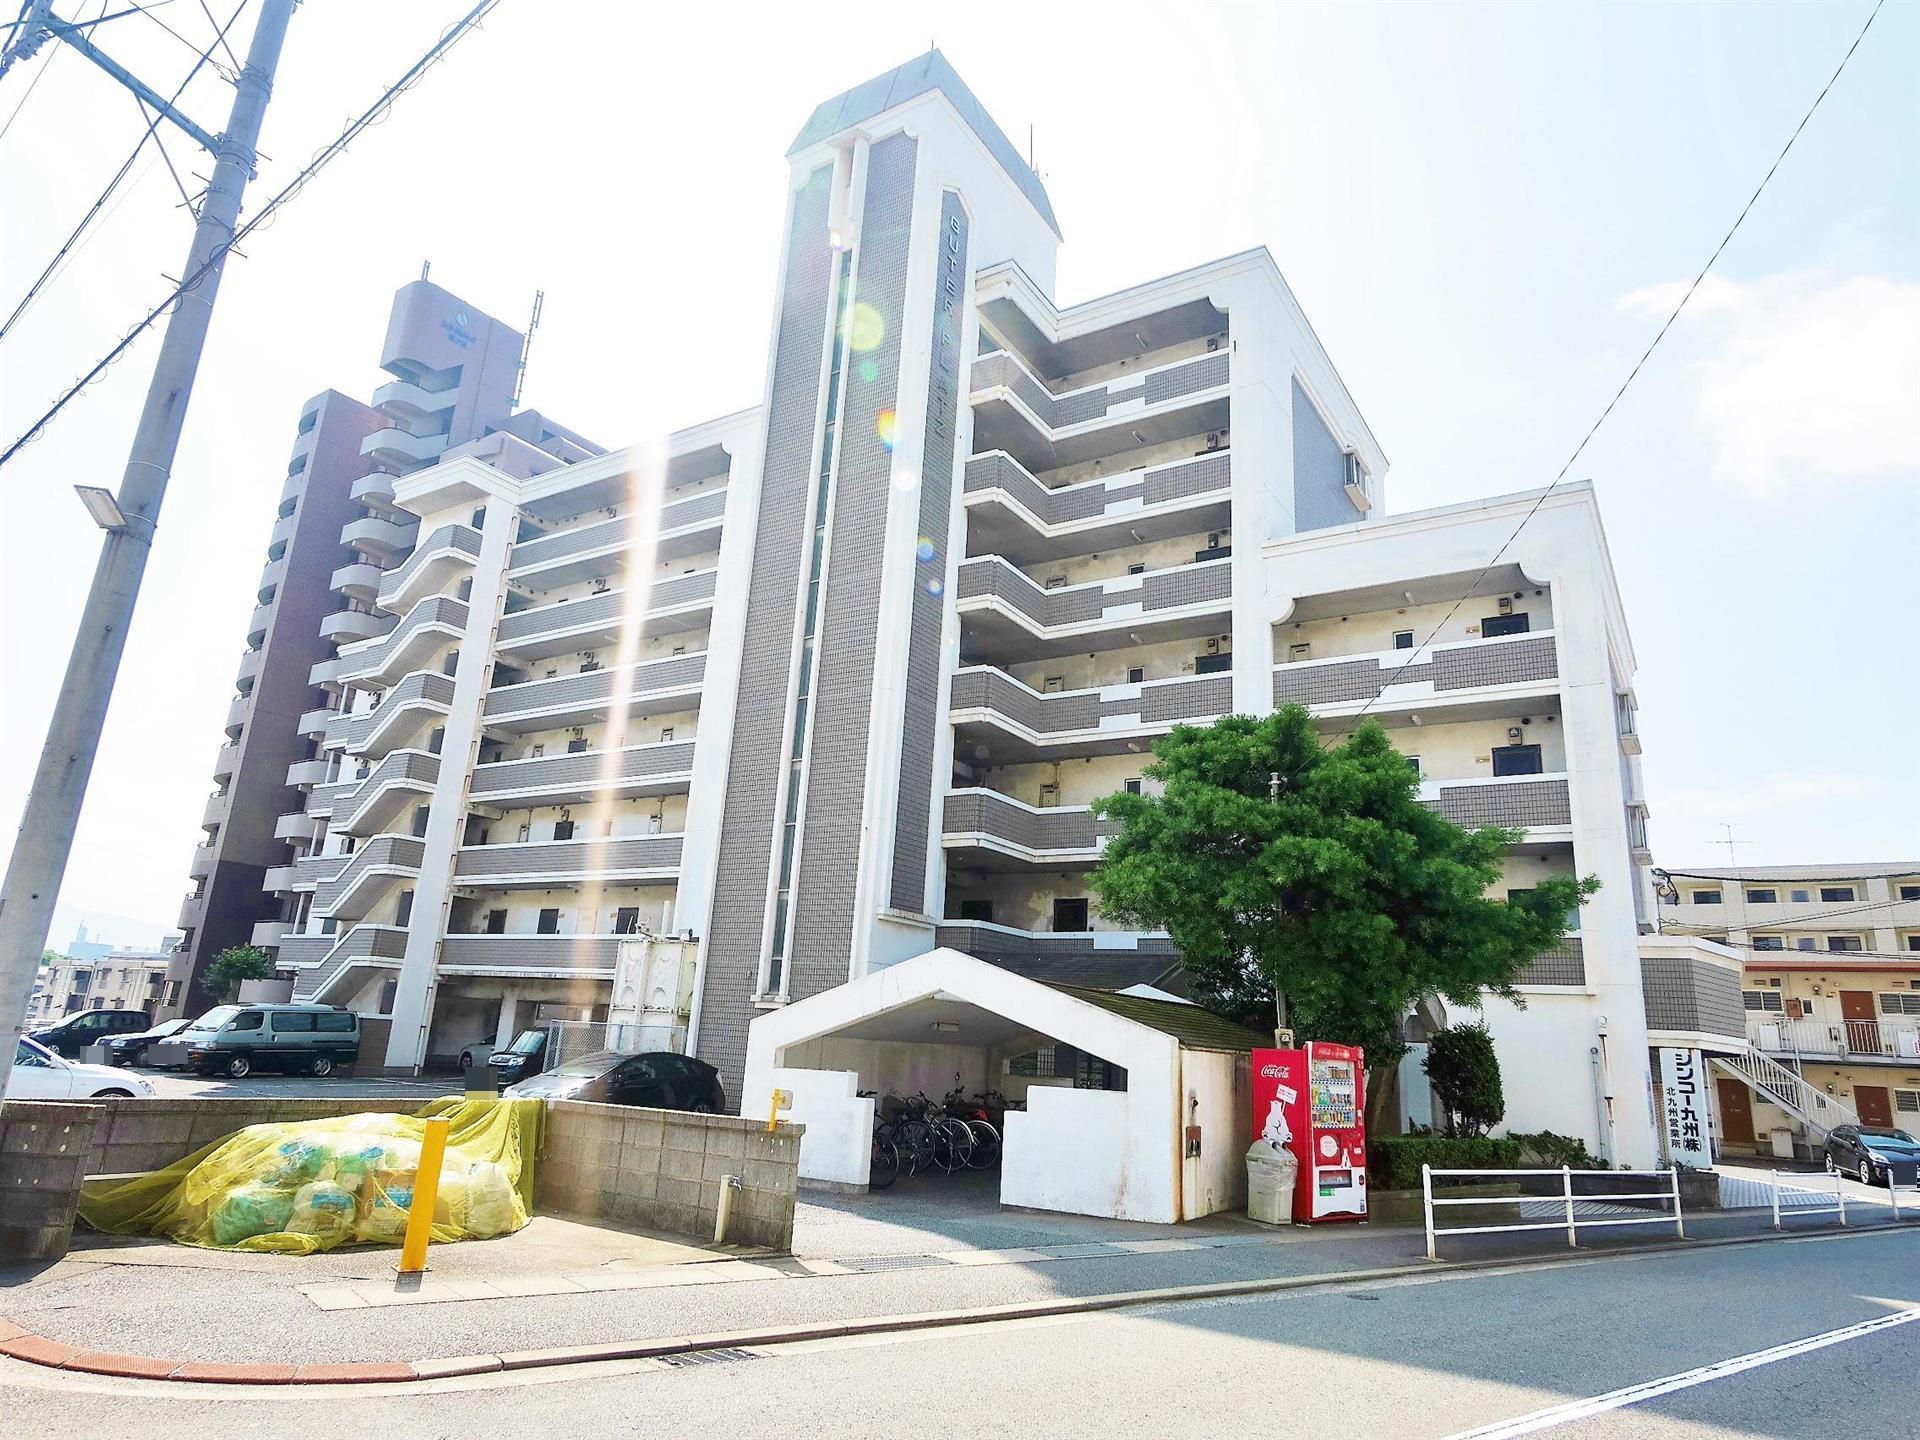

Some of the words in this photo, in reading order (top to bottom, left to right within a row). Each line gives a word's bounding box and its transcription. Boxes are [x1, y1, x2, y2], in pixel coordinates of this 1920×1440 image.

[1667, 1087, 1681, 1148] 北九州営業所
